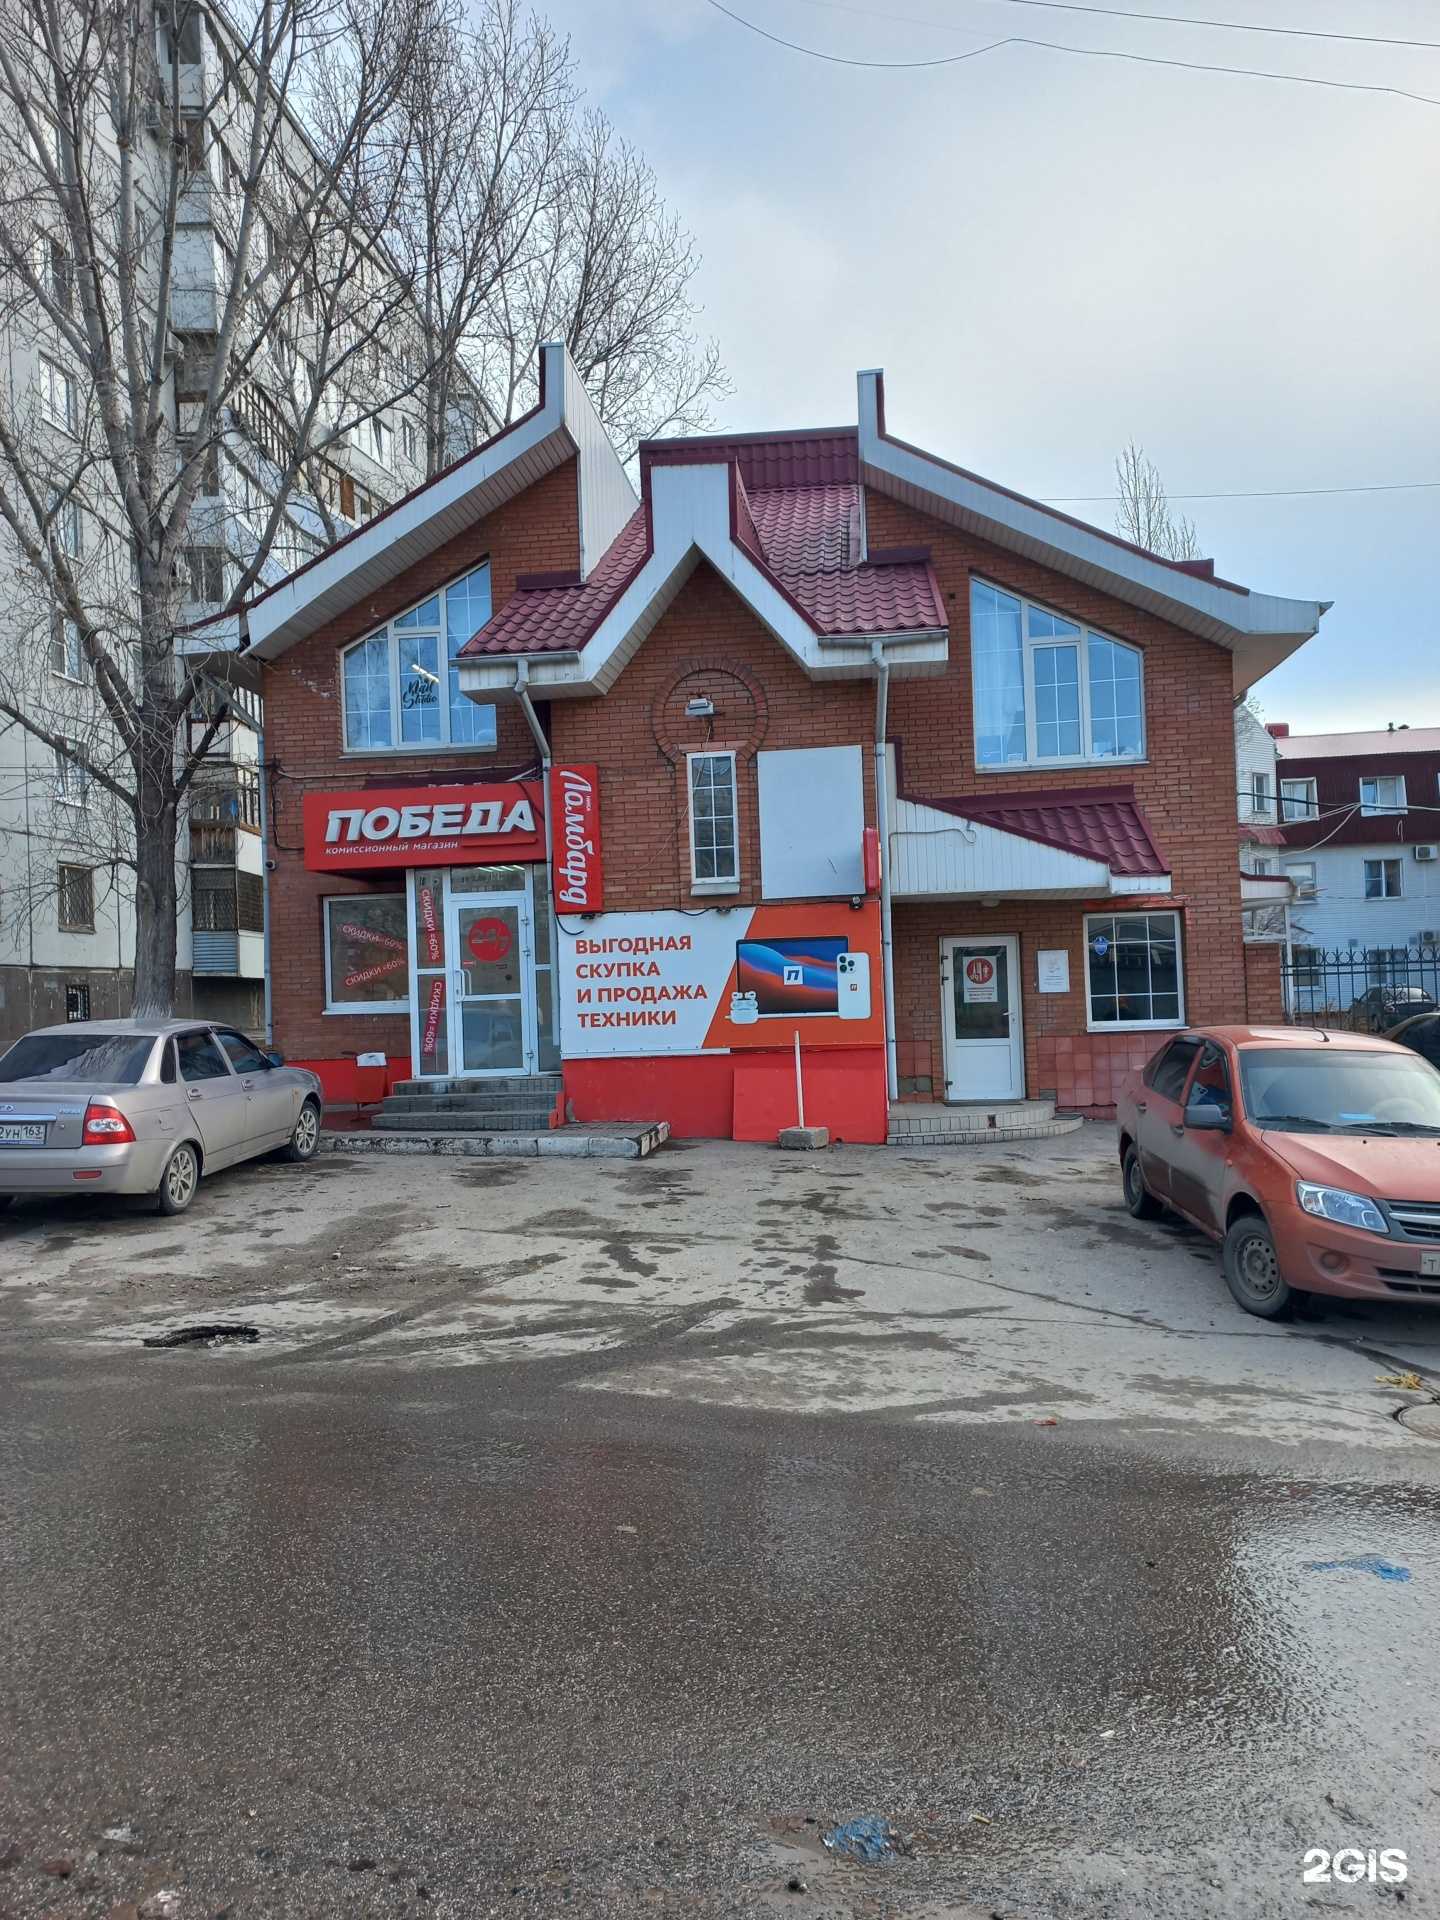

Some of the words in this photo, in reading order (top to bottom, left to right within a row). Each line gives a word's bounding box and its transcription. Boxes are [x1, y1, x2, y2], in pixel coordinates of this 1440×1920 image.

[324, 799, 536, 842] ПОБЕДА
[325, 842, 408, 855] комиссионный
[413, 840, 458, 850] магазин
[558, 770, 594, 905] Ломбард
[422, 889, 435, 932] СКИДКИ
[575, 935, 692, 955] ВЫГОДНАЯ
[575, 961, 661, 979] СКУПКА
[428, 982, 443, 1024] СКИДКИ
[577, 989, 592, 1004] И
[598, 984, 708, 1003] ПРОДАЖА
[577, 1010, 677, 1028] ТЕХНИКИ
[23, 1126, 41, 1136] 163
